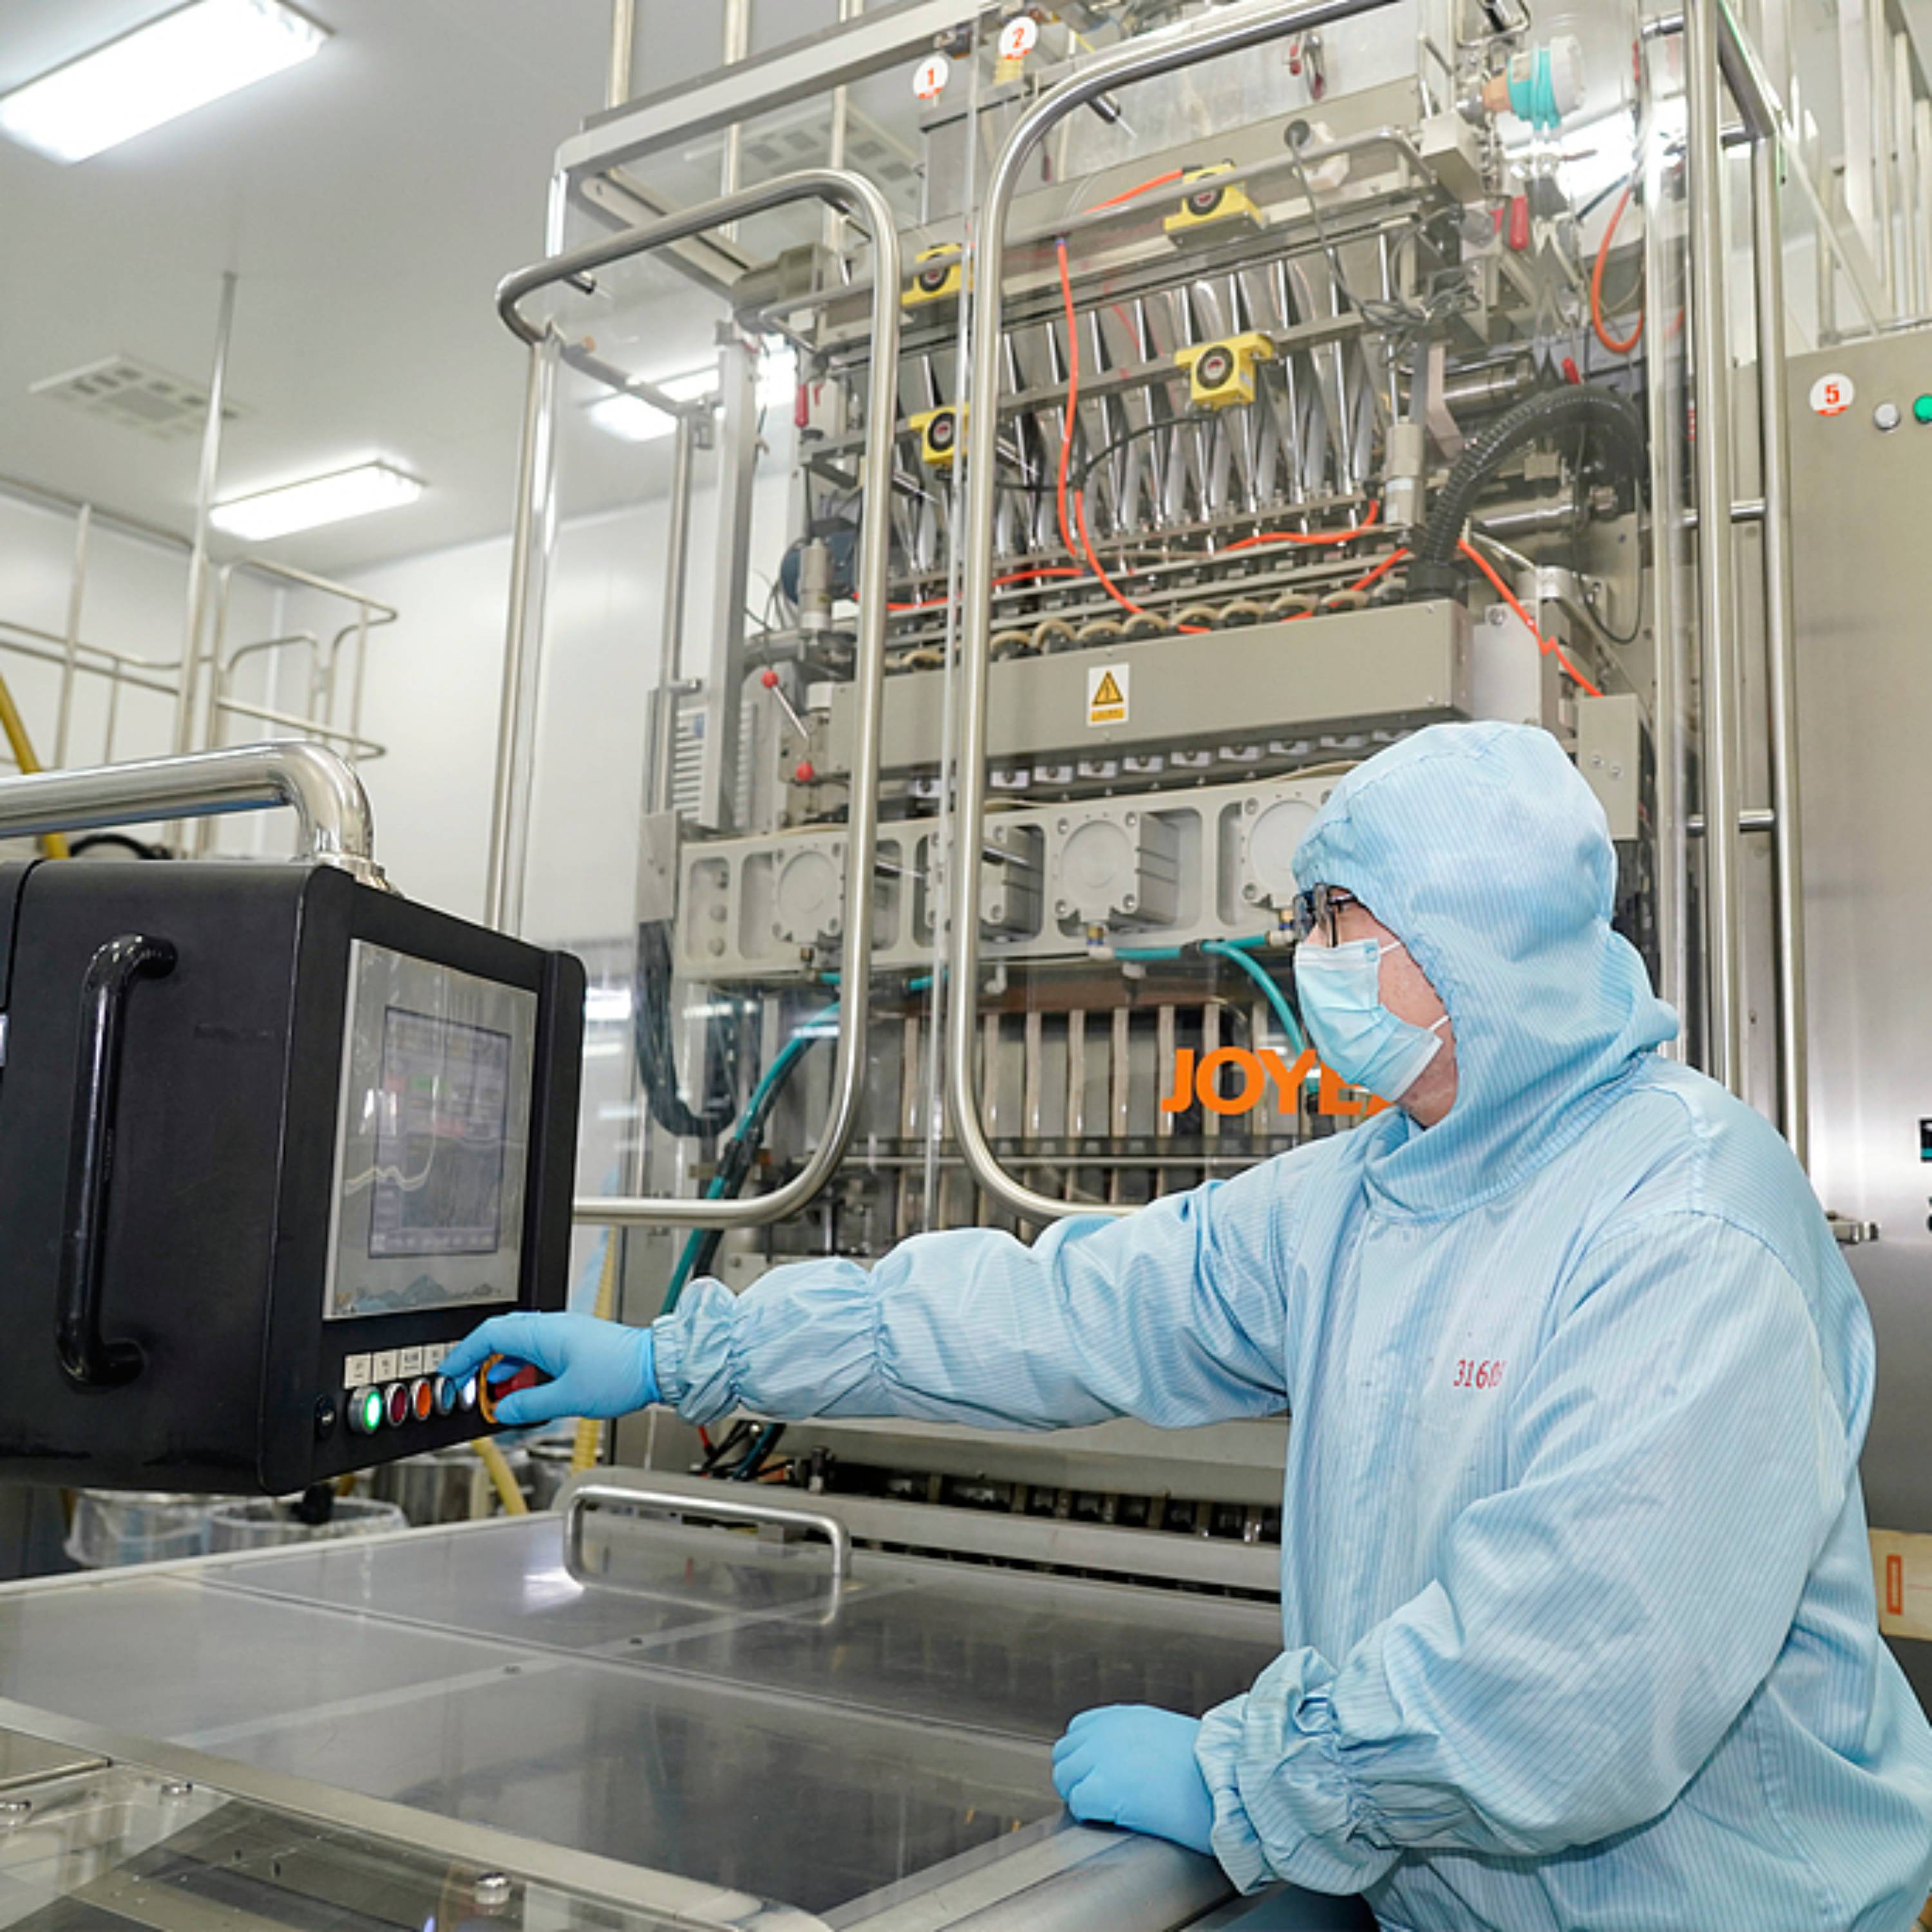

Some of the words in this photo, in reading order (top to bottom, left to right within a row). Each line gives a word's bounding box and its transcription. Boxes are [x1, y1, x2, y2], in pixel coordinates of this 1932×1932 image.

[1012, 26, 1025, 48] 2
[927, 66, 934, 86] 1
[1824, 383, 1840, 405] 5
[1160, 1045, 1396, 1115] JOYE
